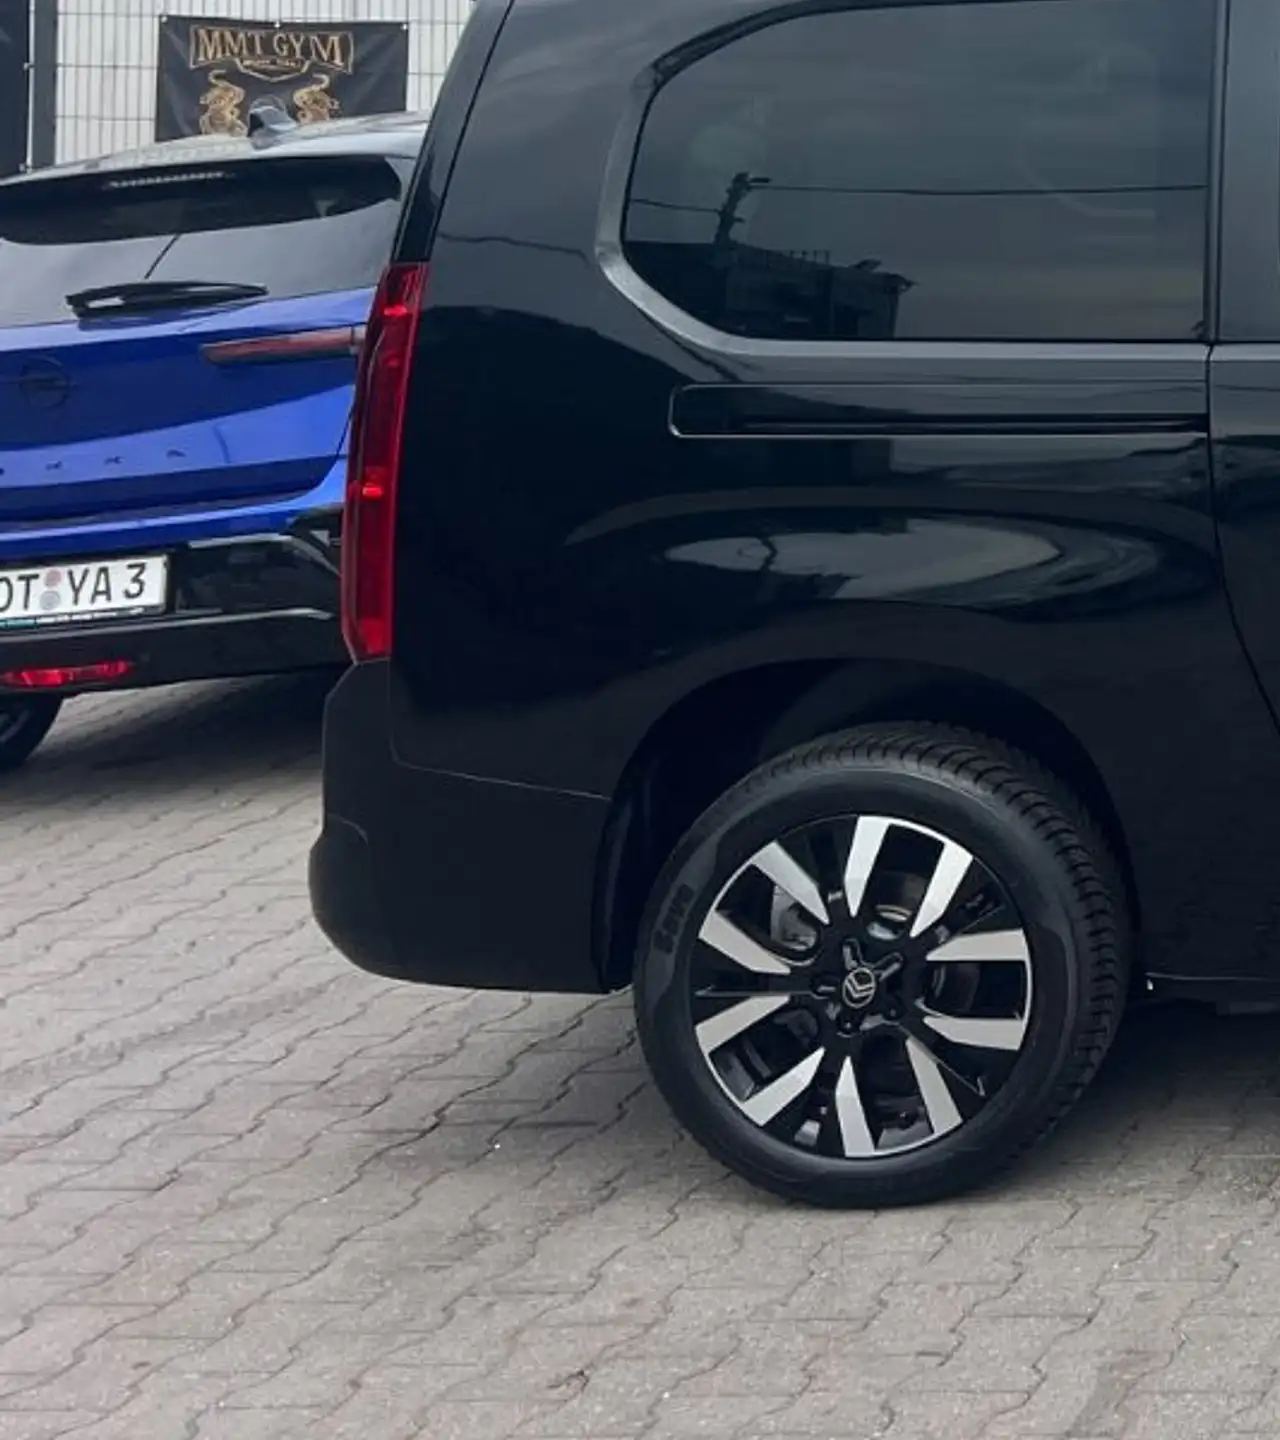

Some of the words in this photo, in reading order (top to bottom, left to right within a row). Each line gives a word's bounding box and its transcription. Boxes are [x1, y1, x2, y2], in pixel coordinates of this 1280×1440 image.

[198, 28, 266, 61] MMT
[272, 32, 345, 66] GYM
[67, 565, 113, 606] YA
[123, 562, 148, 599] 3
